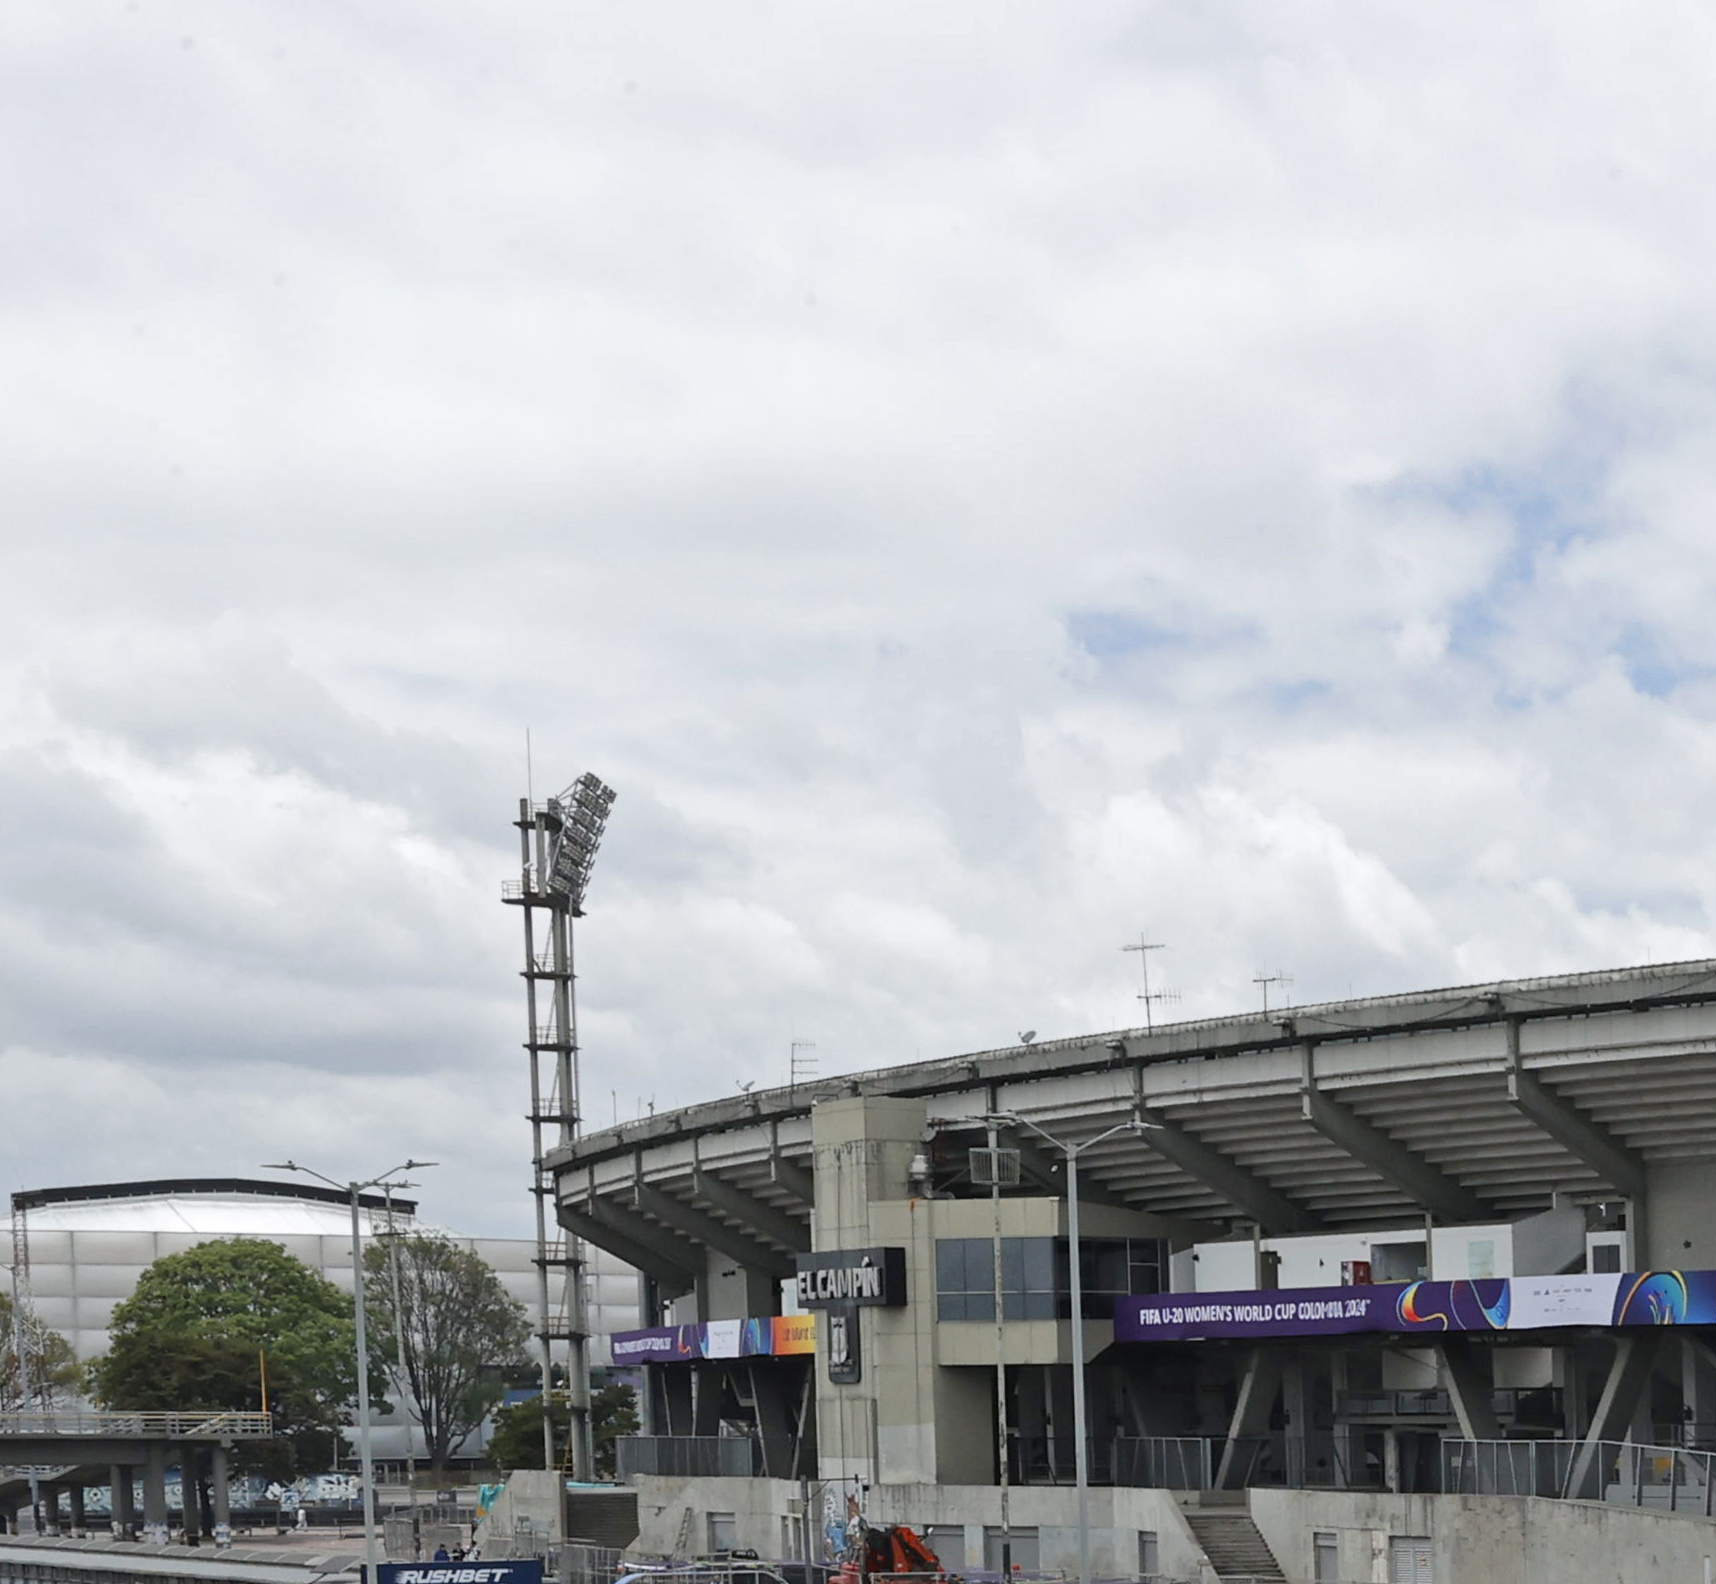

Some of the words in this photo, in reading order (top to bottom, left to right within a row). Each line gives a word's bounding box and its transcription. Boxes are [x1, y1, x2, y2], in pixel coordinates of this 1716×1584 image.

[797, 1271, 817, 1300] EL
[817, 1256, 881, 1299] CAMPÍN
[1140, 1308, 1161, 1325] FIFA
[1162, 1307, 1184, 1323] U-20
[1185, 1306, 1233, 1322] WOMEN'S
[1234, 1305, 1273, 1321] WORLD
[1275, 1303, 1296, 1320] CUP
[1298, 1301, 1343, 1319] COLOMBIA
[394, 1569, 509, 1584] RUSHBET
